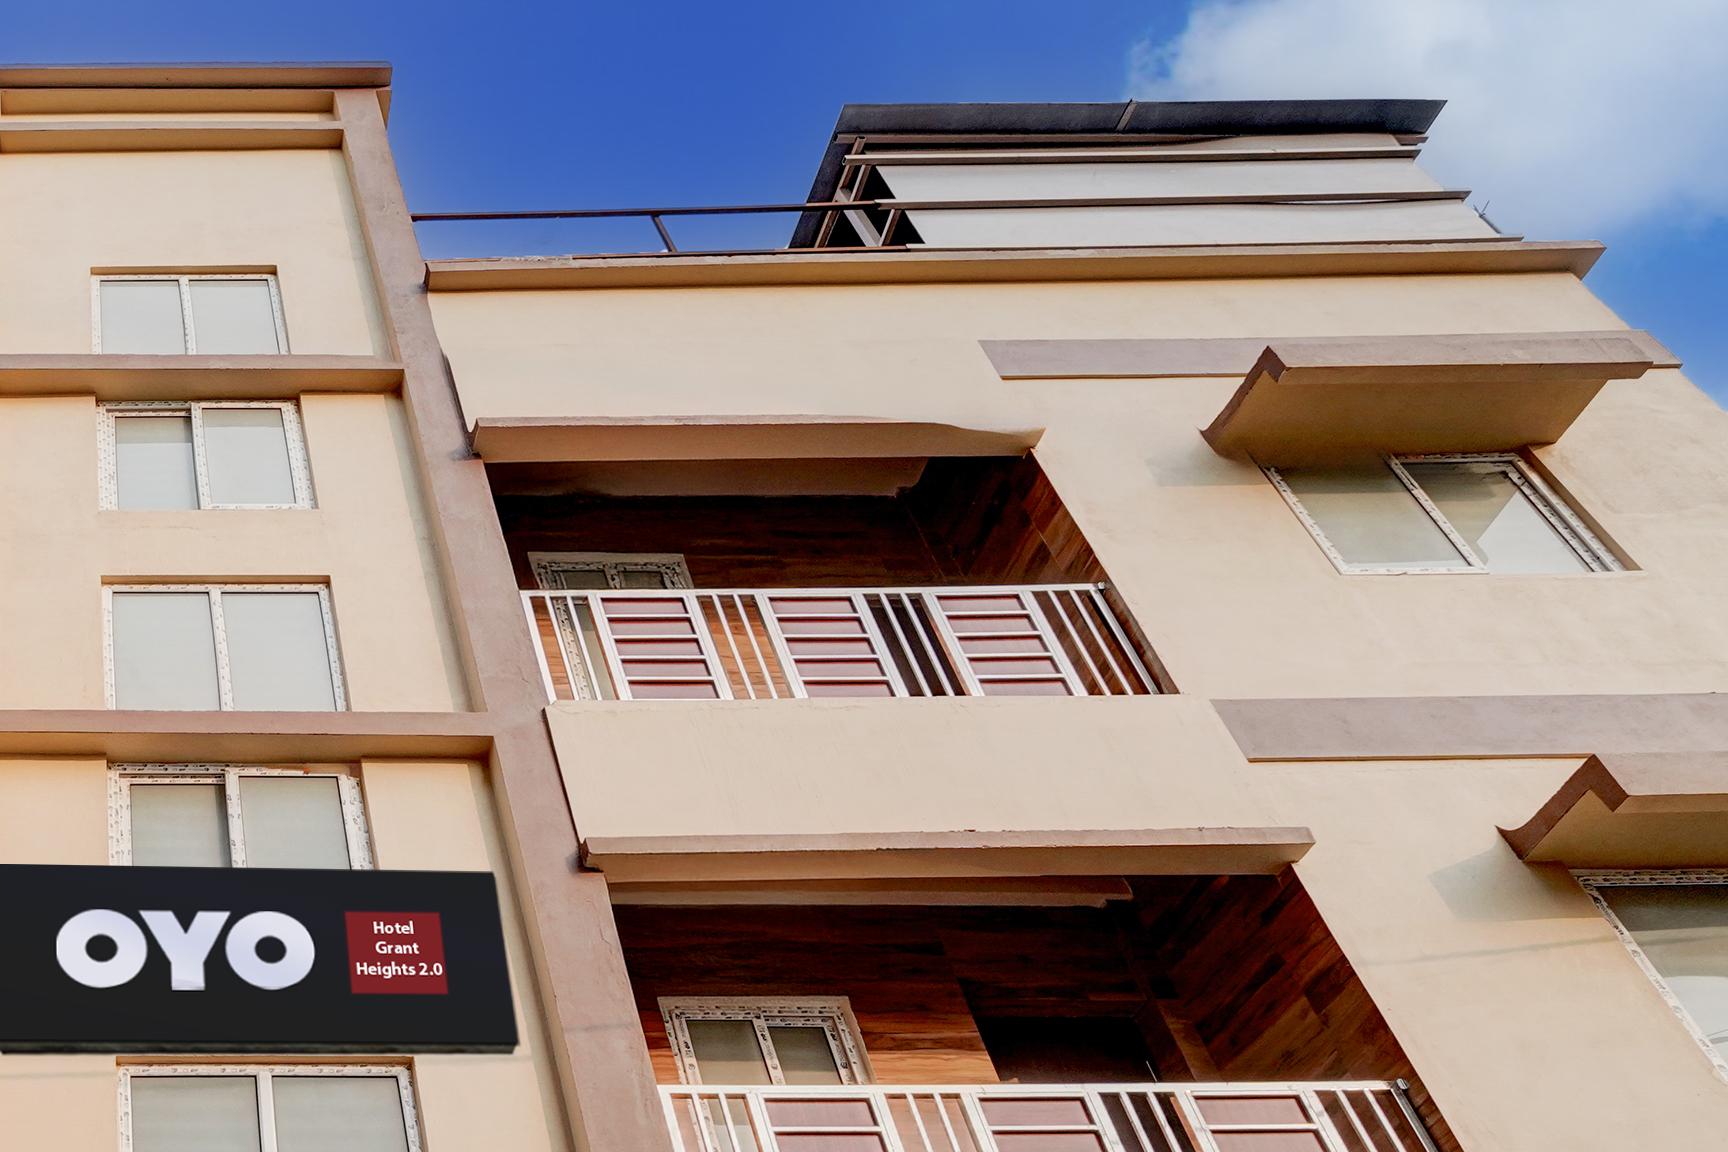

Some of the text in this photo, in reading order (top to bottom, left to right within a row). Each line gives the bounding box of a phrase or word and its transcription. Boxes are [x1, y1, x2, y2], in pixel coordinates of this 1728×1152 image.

[373, 920, 414, 934] Hotel
[56, 909, 315, 991] OYO
[375, 941, 420, 954] Grant
[356, 961, 443, 979] Heights 2.0
